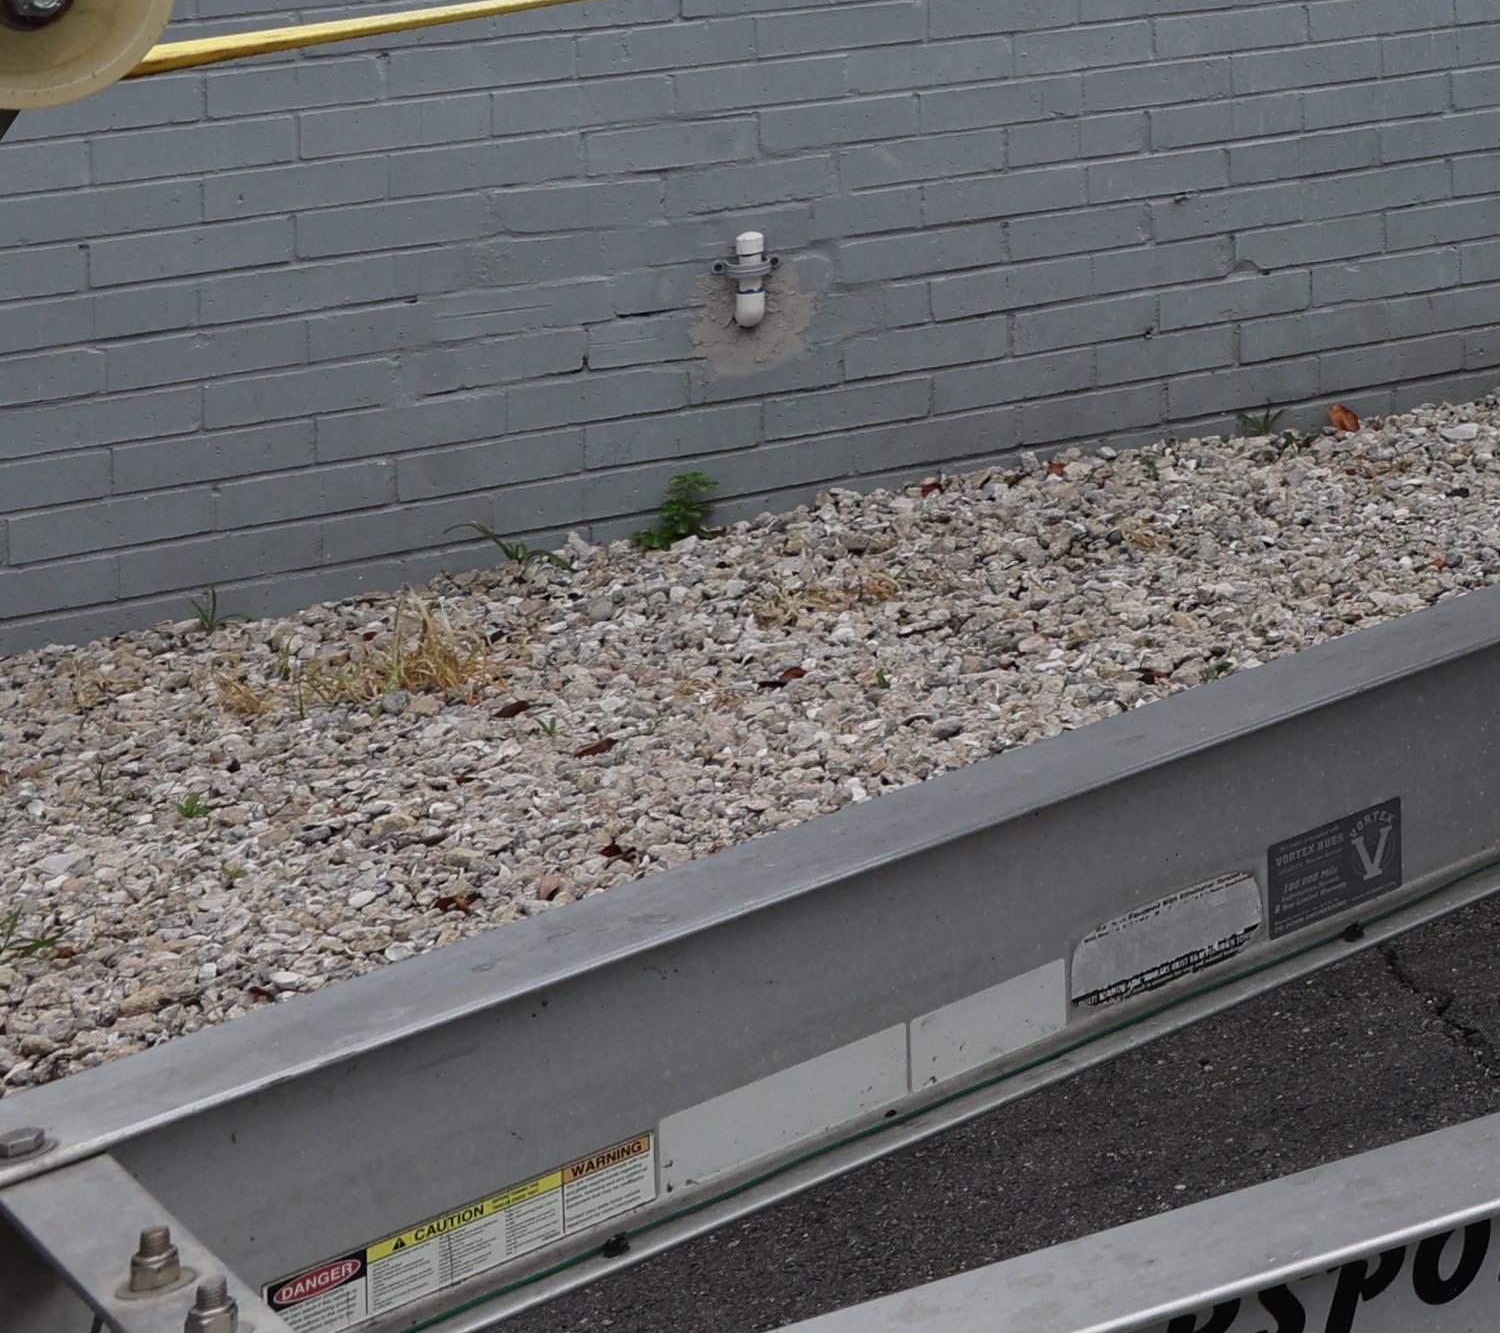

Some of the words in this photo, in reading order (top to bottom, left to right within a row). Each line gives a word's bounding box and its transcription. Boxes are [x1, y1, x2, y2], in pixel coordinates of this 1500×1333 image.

[1349, 810, 1394, 838] VORTEX
[1275, 844, 1315, 866] VORTEX
[570, 1141, 642, 1178] WARNING
[414, 1204, 484, 1242] CAUTION
[281, 1262, 353, 1302] DANGER
